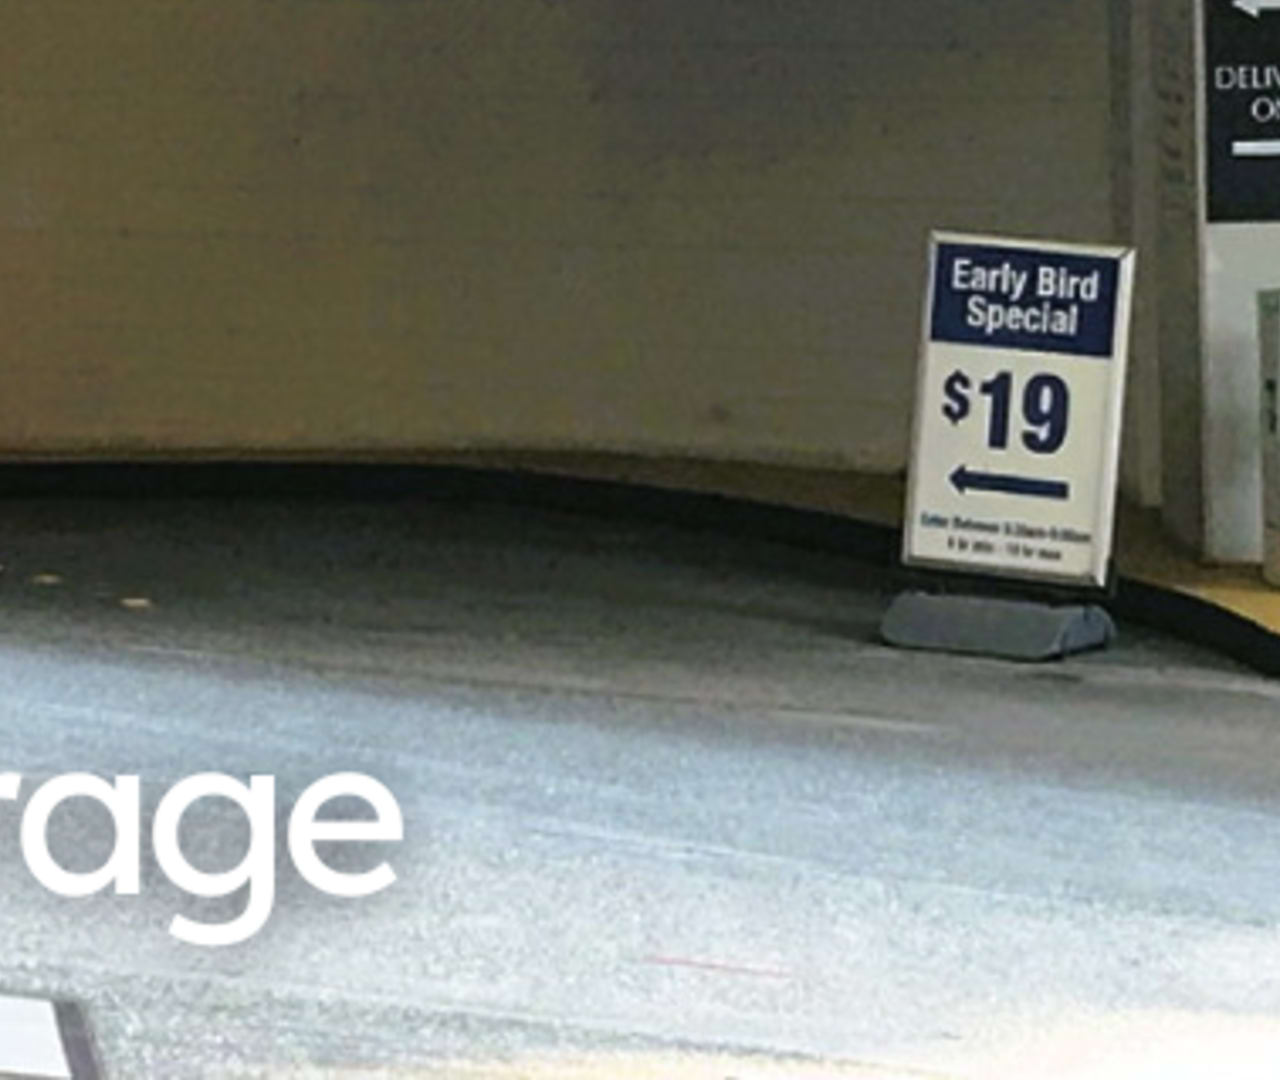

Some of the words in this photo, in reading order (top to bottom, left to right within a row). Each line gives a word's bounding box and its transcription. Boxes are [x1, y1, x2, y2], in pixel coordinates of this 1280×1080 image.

[952, 259, 1027, 300] Early
[1037, 266, 1098, 300] Bird
[967, 295, 1078, 335] Special
[942, 370, 1069, 453] $19
